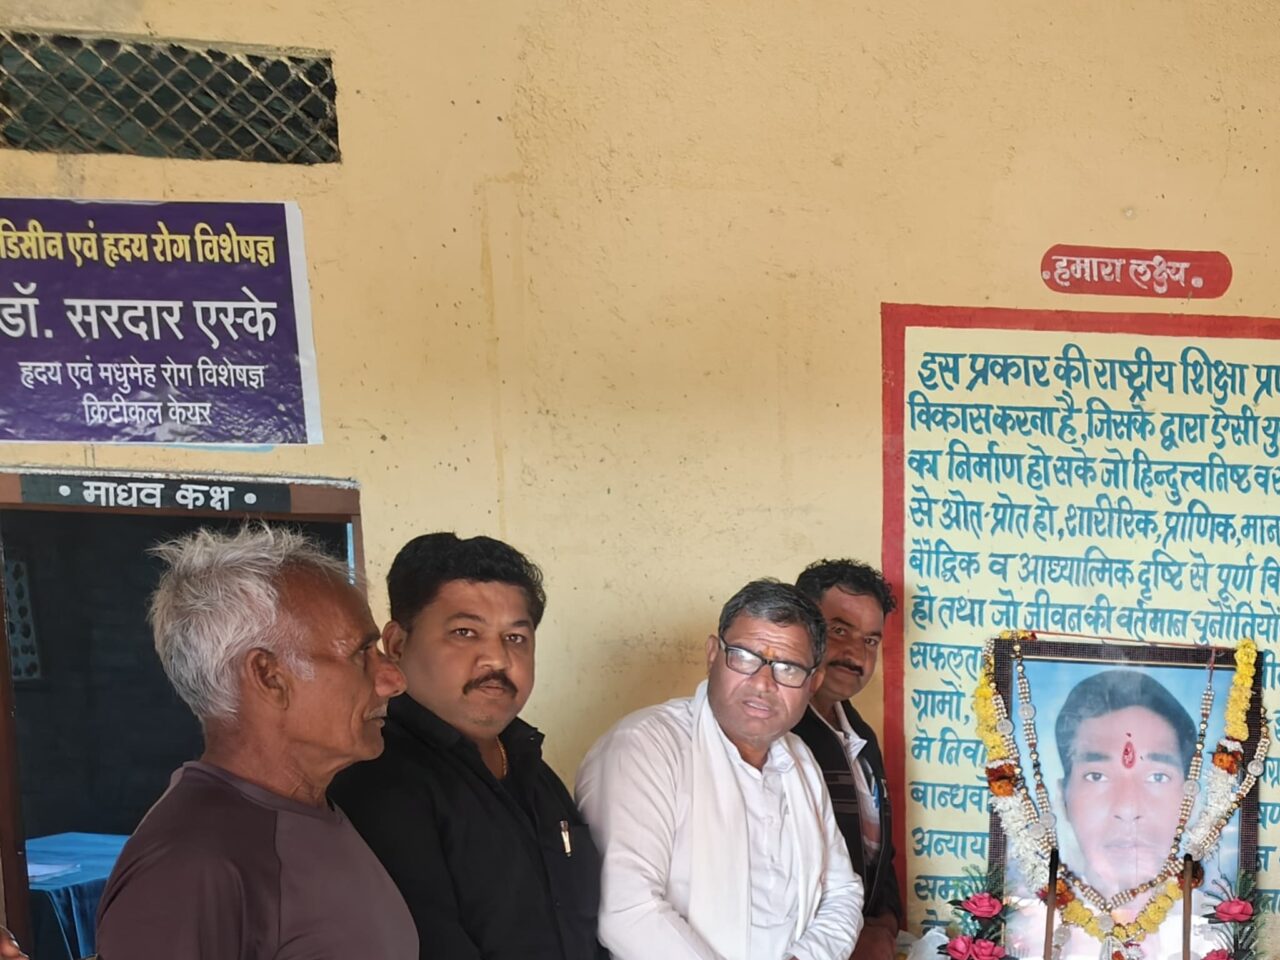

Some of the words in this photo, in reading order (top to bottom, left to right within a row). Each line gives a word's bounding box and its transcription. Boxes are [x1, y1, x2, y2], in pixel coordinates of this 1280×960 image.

[0, 218, 64, 260] डिसीन
[66, 219, 98, 267] एवं
[101, 232, 148, 268] हृदय
[152, 221, 192, 263] रोग
[195, 222, 276, 267] विशेषज्ञ
[1052, 255, 1126, 286] हमारा
[1129, 255, 1190, 294] लक्ष्य
[64, 299, 183, 341] सरदार
[193, 286, 277, 350] एस्के
[19, 361, 62, 389] हृदय
[67, 355, 94, 389] एवं
[99, 355, 156, 394] मधुमेह
[161, 356, 192, 387] रोग
[197, 356, 267, 389] विशेषज्ञ
[918, 352, 967, 391] इस
[966, 353, 1050, 391] प्रकार
[1053, 343, 1092, 390] की
[1094, 347, 1177, 402] राष्ट्रीय
[1180, 346, 1249, 404] शिक्षा
[82, 392, 163, 426] क्रिटीकल
[168, 394, 213, 425] केयर
[907, 390, 994, 434] विकास
[996, 404, 1061, 436] करना
[1160, 412, 1210, 451] द्वारा
[1210, 404, 1261, 450] ऐसी
[907, 449, 943, 481] का
[946, 438, 1026, 484] निर्माण
[1025, 442, 1054, 490] हो
[1053, 446, 1097, 487] सके
[1099, 446, 1131, 490] जो
[1254, 465, 1276, 495] व
[83, 480, 164, 506] माधव
[175, 484, 235, 511] कक्ष
[909, 484, 941, 529] से
[988, 552, 1018, 583] व
[1138, 549, 1188, 600] दृष्टि
[1189, 549, 1215, 592] से
[1216, 552, 1258, 602] पूर्ण
[911, 584, 938, 630] हो
[938, 596, 987, 629] तथा
[989, 588, 1024, 629] जो
[1024, 588, 1085, 633] जीवन
[1085, 594, 1117, 633] की
[1116, 600, 1192, 641] वर्तमान
[910, 642, 985, 681] सफलता
